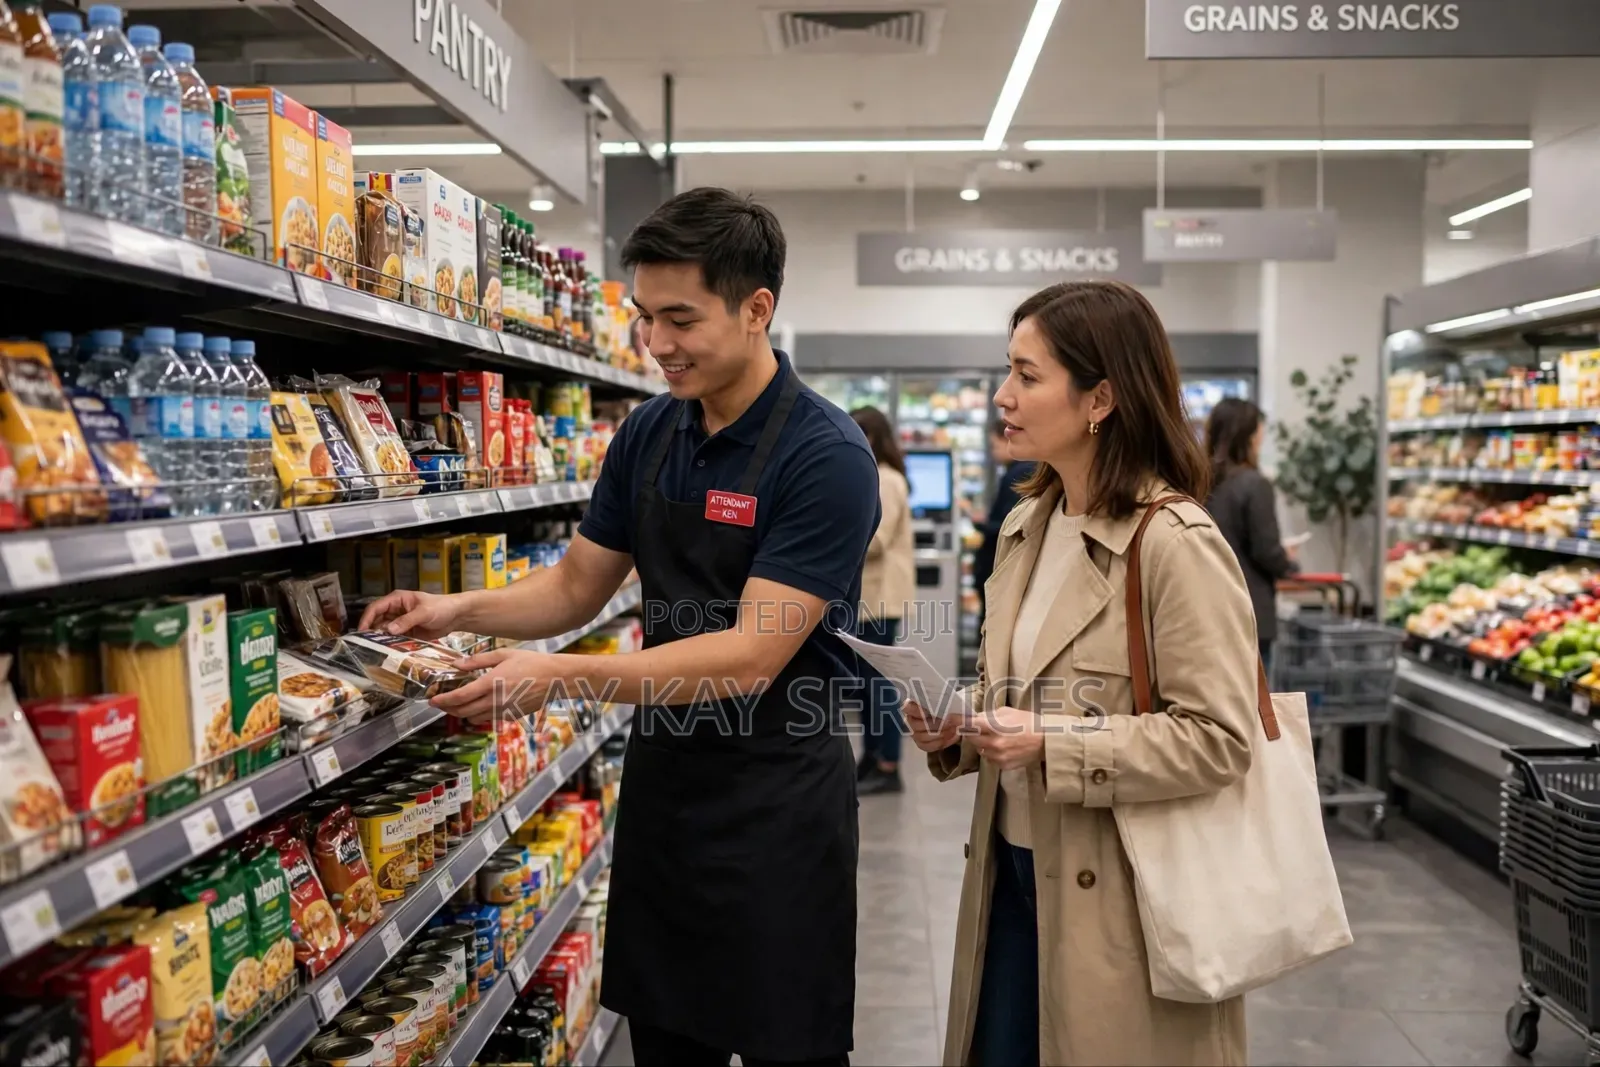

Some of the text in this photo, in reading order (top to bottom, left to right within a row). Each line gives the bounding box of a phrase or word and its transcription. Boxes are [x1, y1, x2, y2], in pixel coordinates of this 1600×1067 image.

[1184, 3, 1460, 32] GRAINS & SNACKS
[413, 0, 512, 113] PANTRY
[894, 247, 1119, 273] GRAINS & SNACKS
[710, 495, 751, 509] ATTENDANT
[722, 508, 738, 519] KEN
